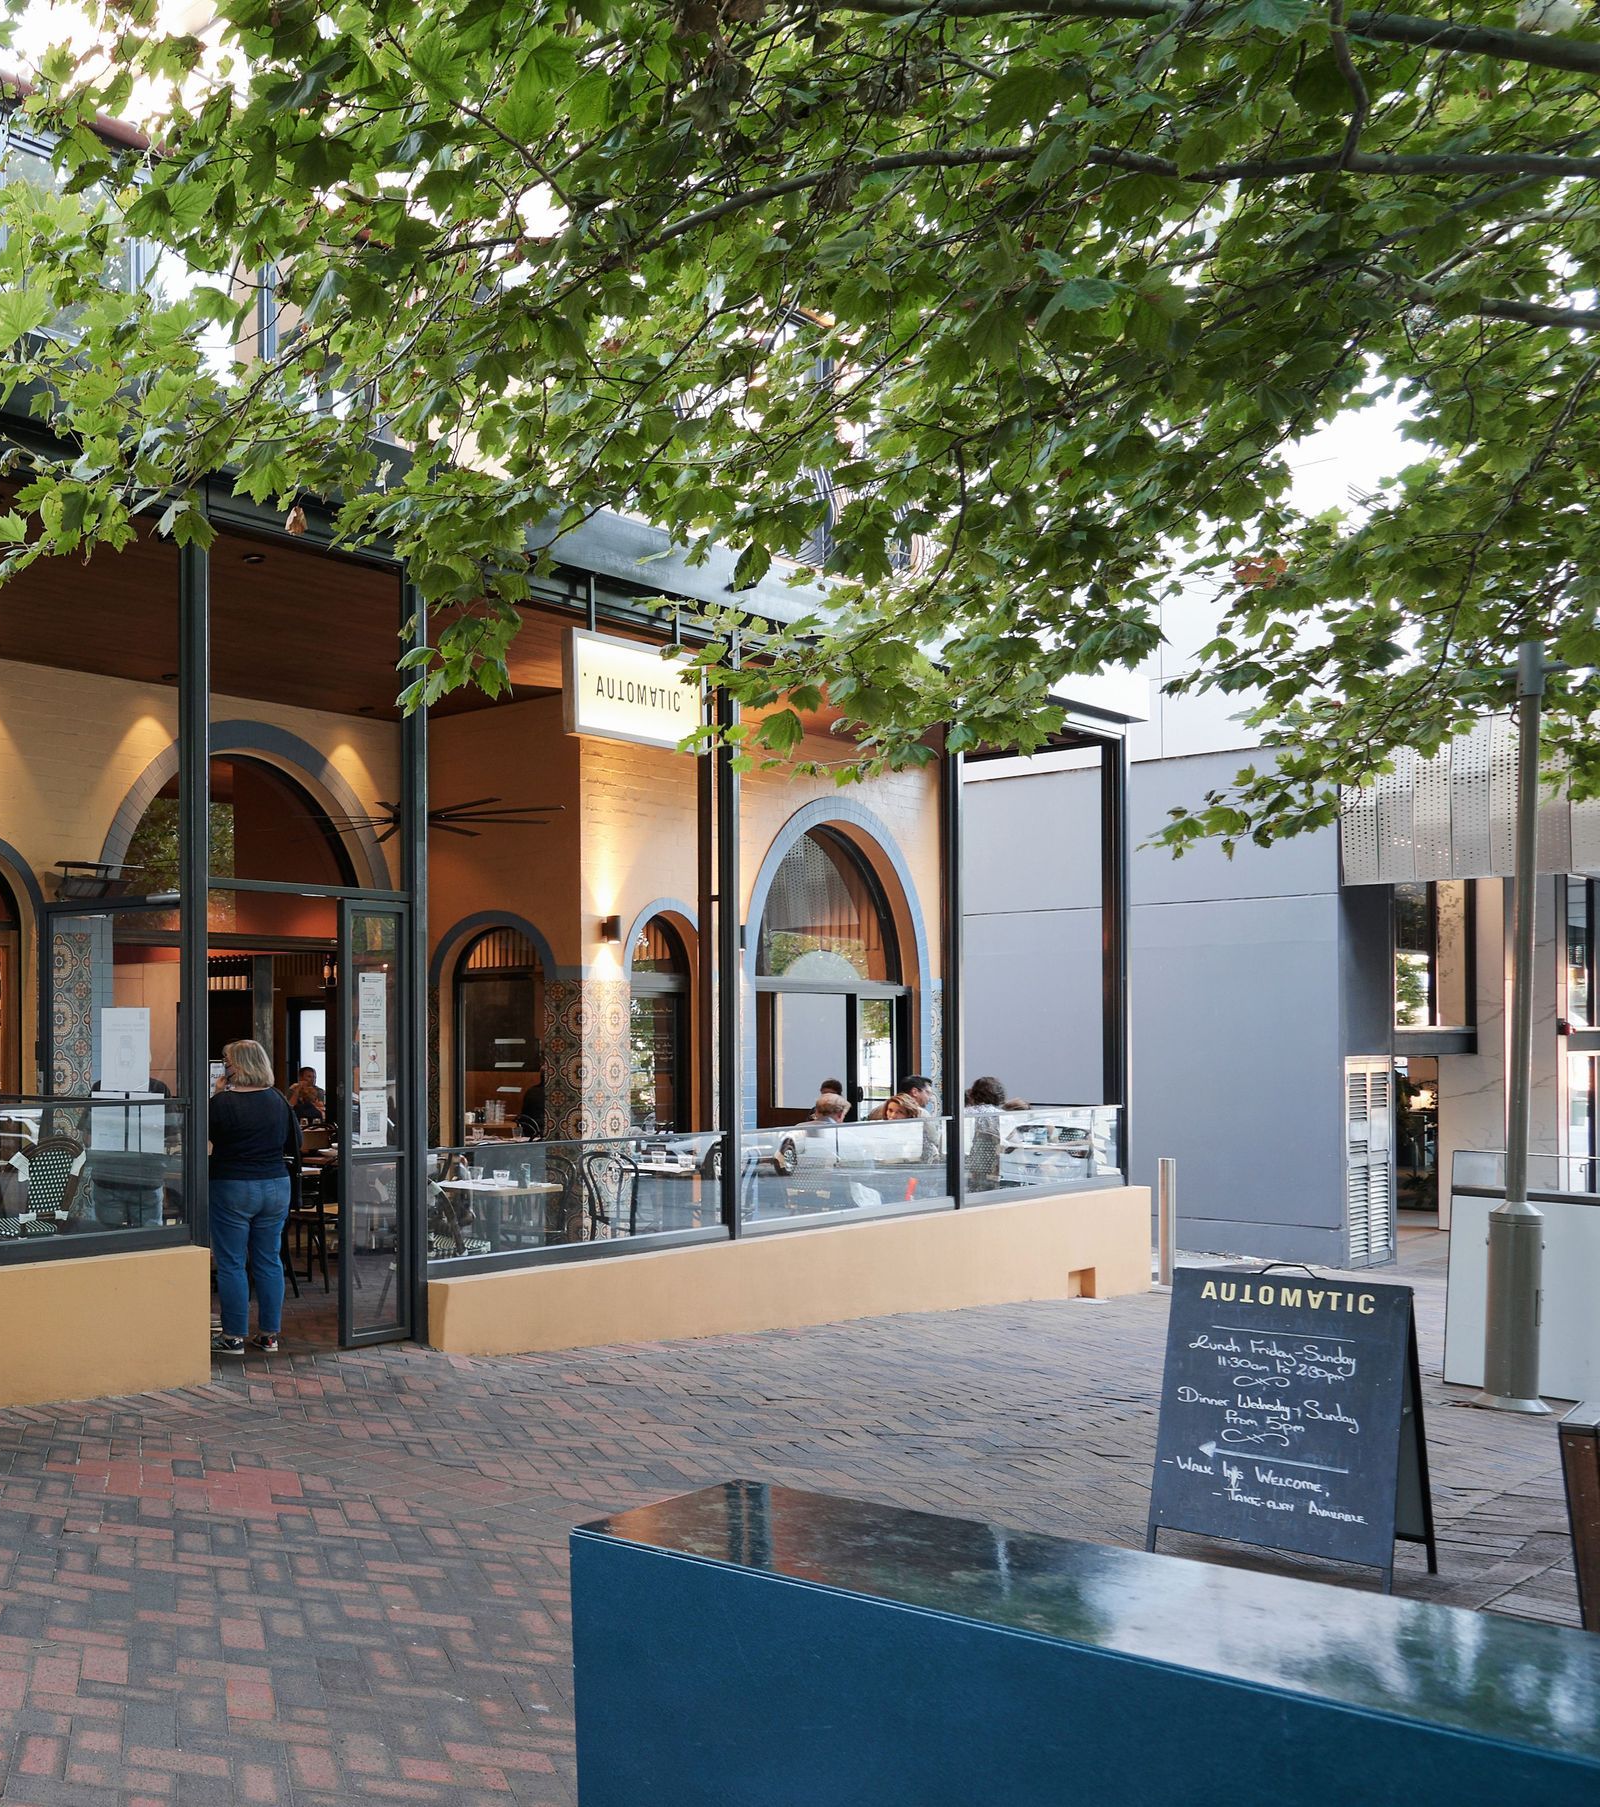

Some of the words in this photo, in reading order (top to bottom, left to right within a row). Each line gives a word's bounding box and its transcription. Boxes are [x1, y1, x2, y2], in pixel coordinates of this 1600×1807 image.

[596, 675, 681, 712] AUTOMATIC
[1200, 1281, 1376, 1315] AUTOMATIC
[1189, 1335, 1241, 1353] Lunch
[1276, 1360, 1291, 1374] to
[1177, 1386, 1230, 1407] Dinner
[1304, 1400, 1360, 1434] Sunday
[1225, 1410, 1258, 1426] from
[1266, 1416, 1305, 1433] 5pm
